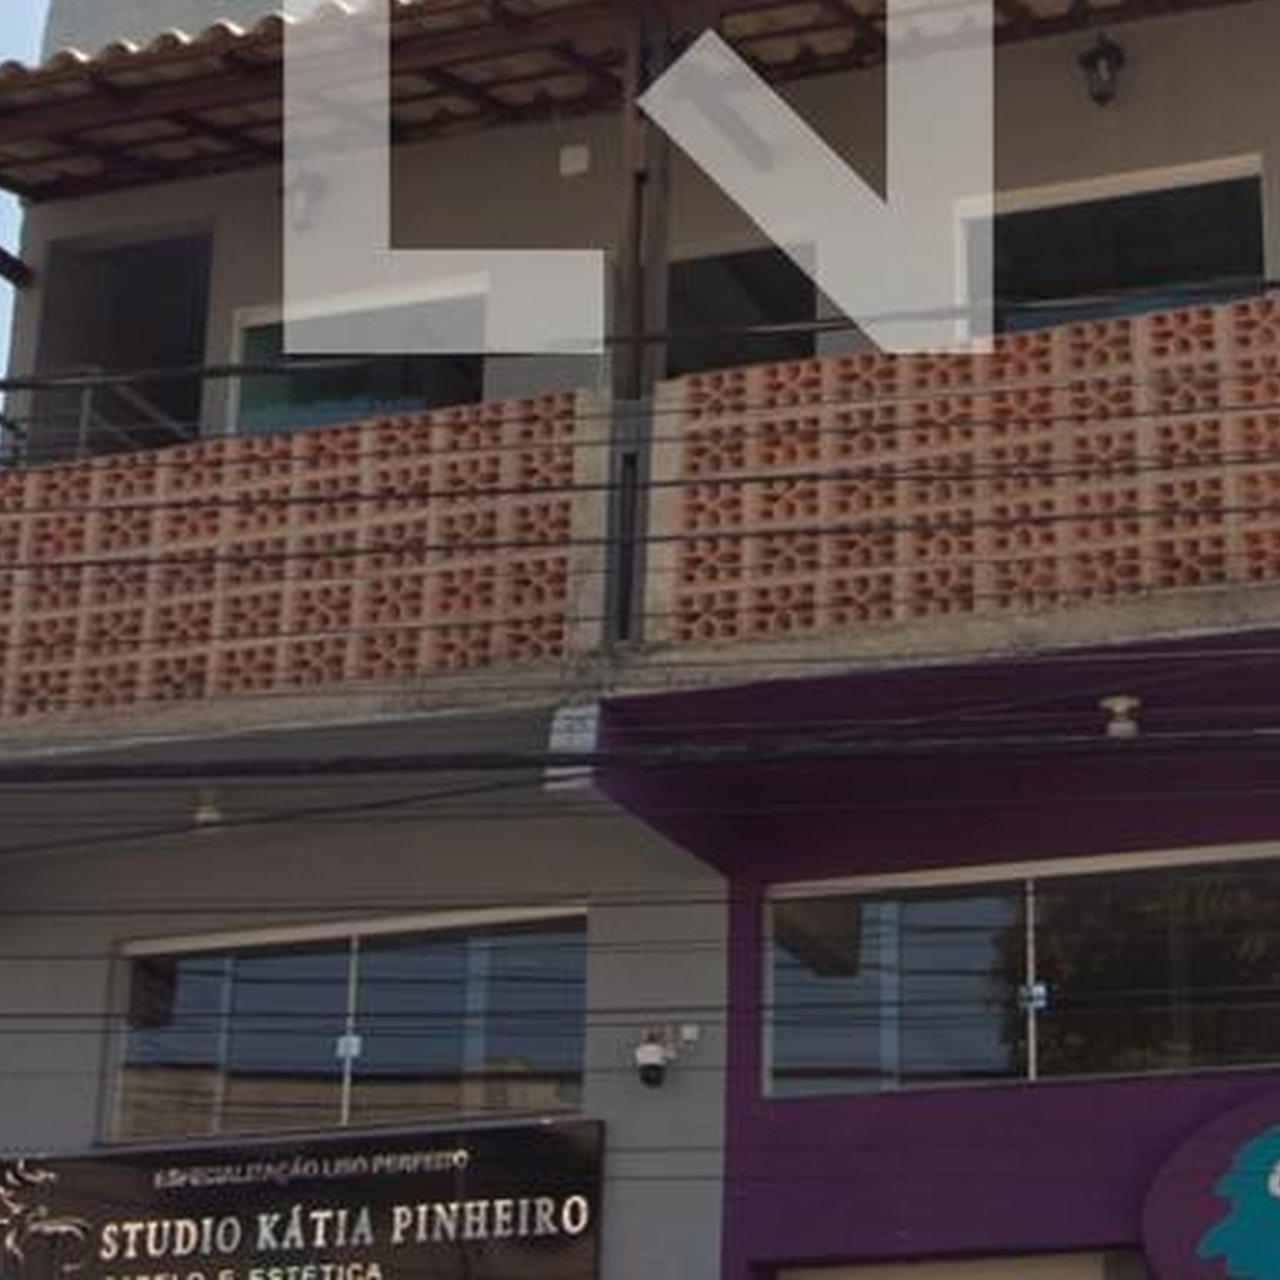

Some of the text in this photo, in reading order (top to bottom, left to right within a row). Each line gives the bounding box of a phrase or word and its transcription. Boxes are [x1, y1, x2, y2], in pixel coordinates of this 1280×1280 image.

[99, 1192, 590, 1261] STUDIO KÁTIA PINHEIRO
